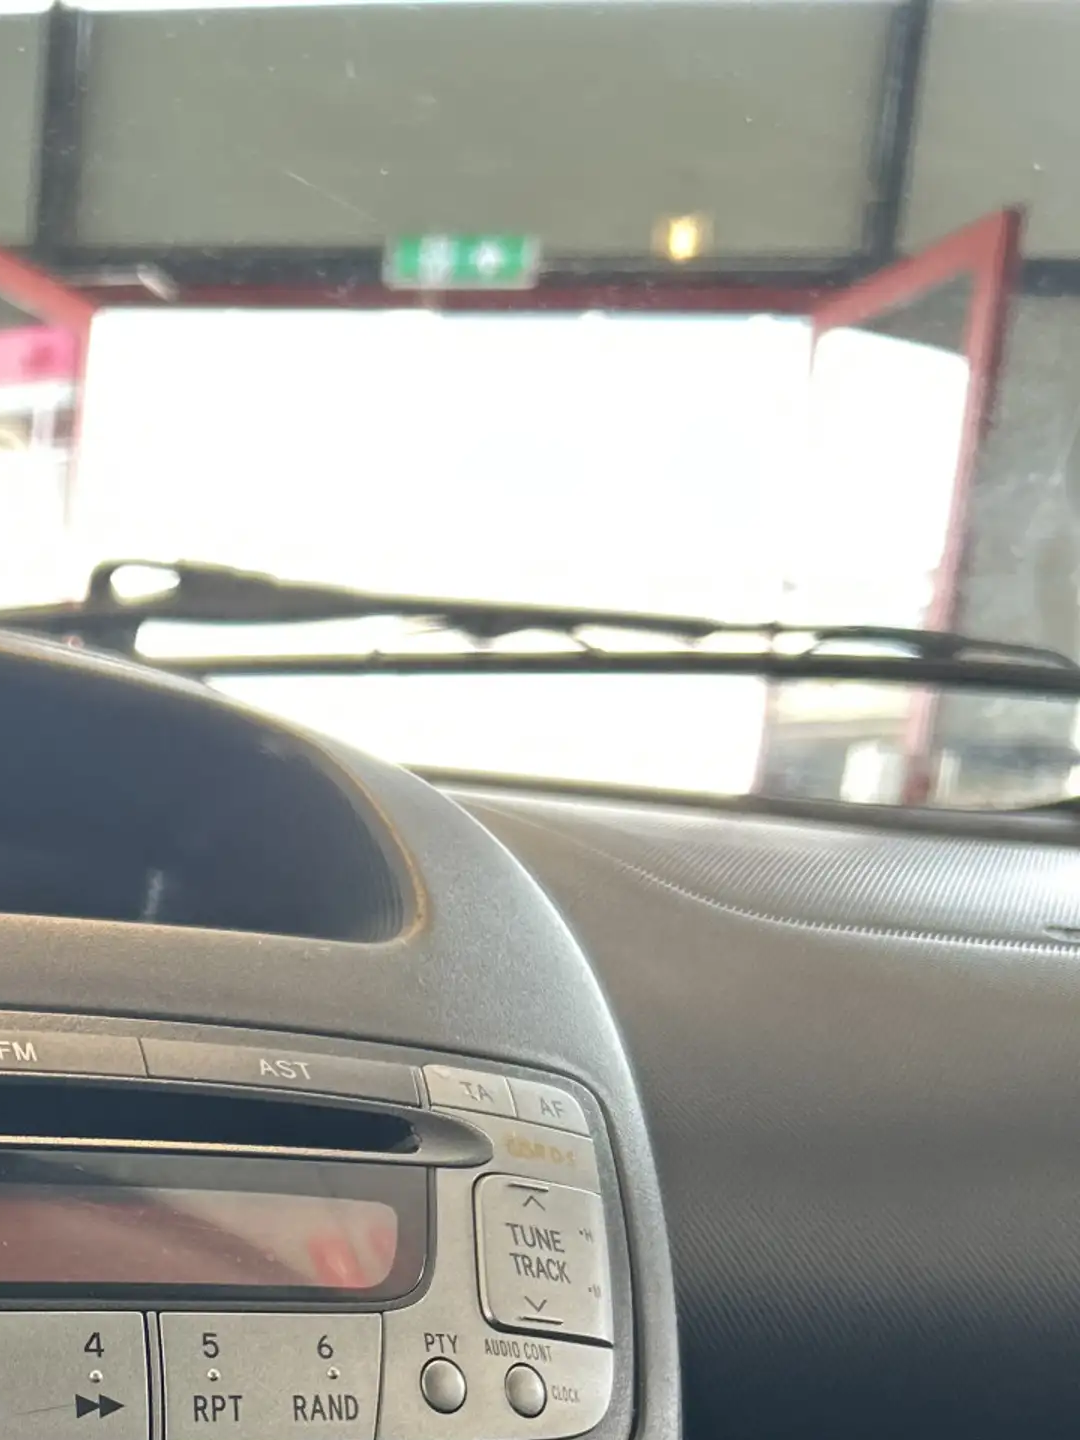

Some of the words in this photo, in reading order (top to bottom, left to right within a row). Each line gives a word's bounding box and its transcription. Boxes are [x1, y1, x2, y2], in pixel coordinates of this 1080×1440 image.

[259, 1058, 312, 1081] AST
[459, 1081, 494, 1103] TA
[539, 1097, 563, 1118] AF
[504, 1222, 566, 1254] TUNE
[509, 1252, 572, 1285] TRACK
[83, 1331, 105, 1357] 4
[202, 1333, 220, 1359] 5
[317, 1334, 334, 1360] 6
[423, 1332, 458, 1354] PTY
[484, 1338, 520, 1359] AUDIO
[523, 1342, 552, 1362] CONT
[551, 1385, 580, 1403] CLOCK
[193, 1395, 243, 1423] RPT
[293, 1394, 360, 1422] RAND
